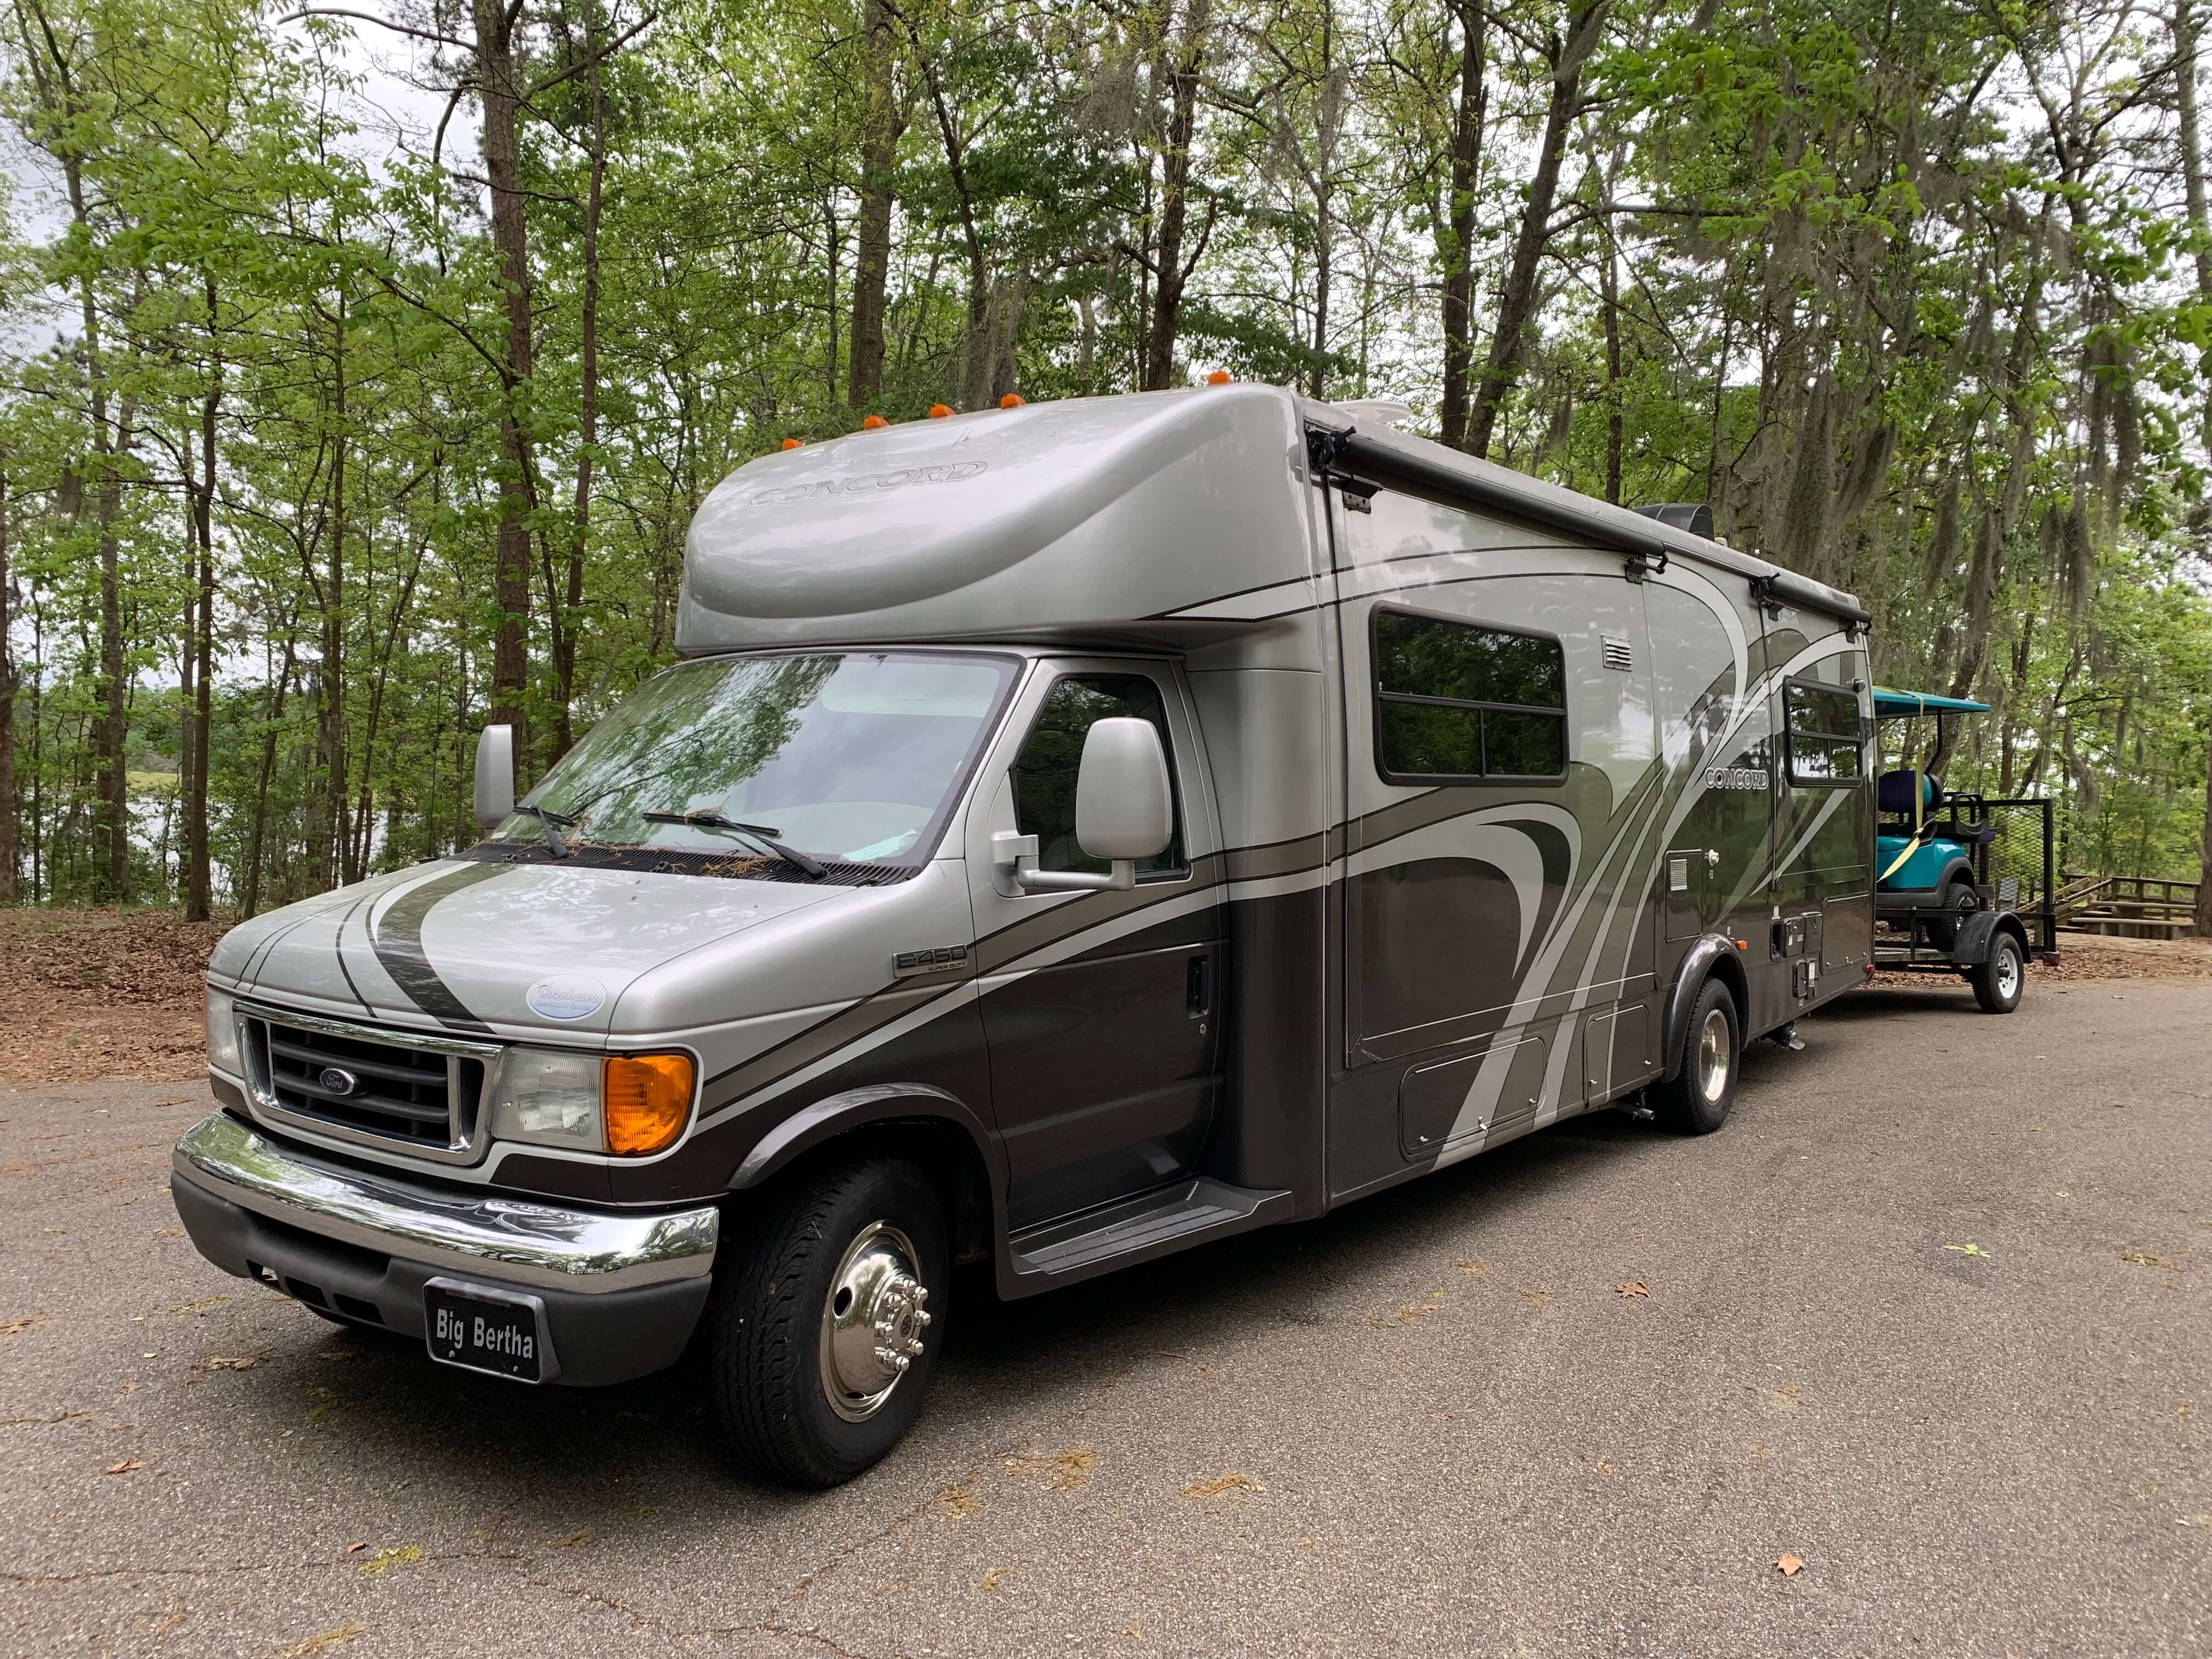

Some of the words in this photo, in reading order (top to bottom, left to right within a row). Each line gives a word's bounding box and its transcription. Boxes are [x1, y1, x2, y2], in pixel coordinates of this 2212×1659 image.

[747, 461, 988, 508] CONCORD
[1705, 767, 1769, 790] CONCORD
[538, 988, 602, 1003] Coachmen
[326, 1073, 343, 1089] Ford
[437, 1308, 464, 1349] Big
[473, 1317, 533, 1359] Bertha
